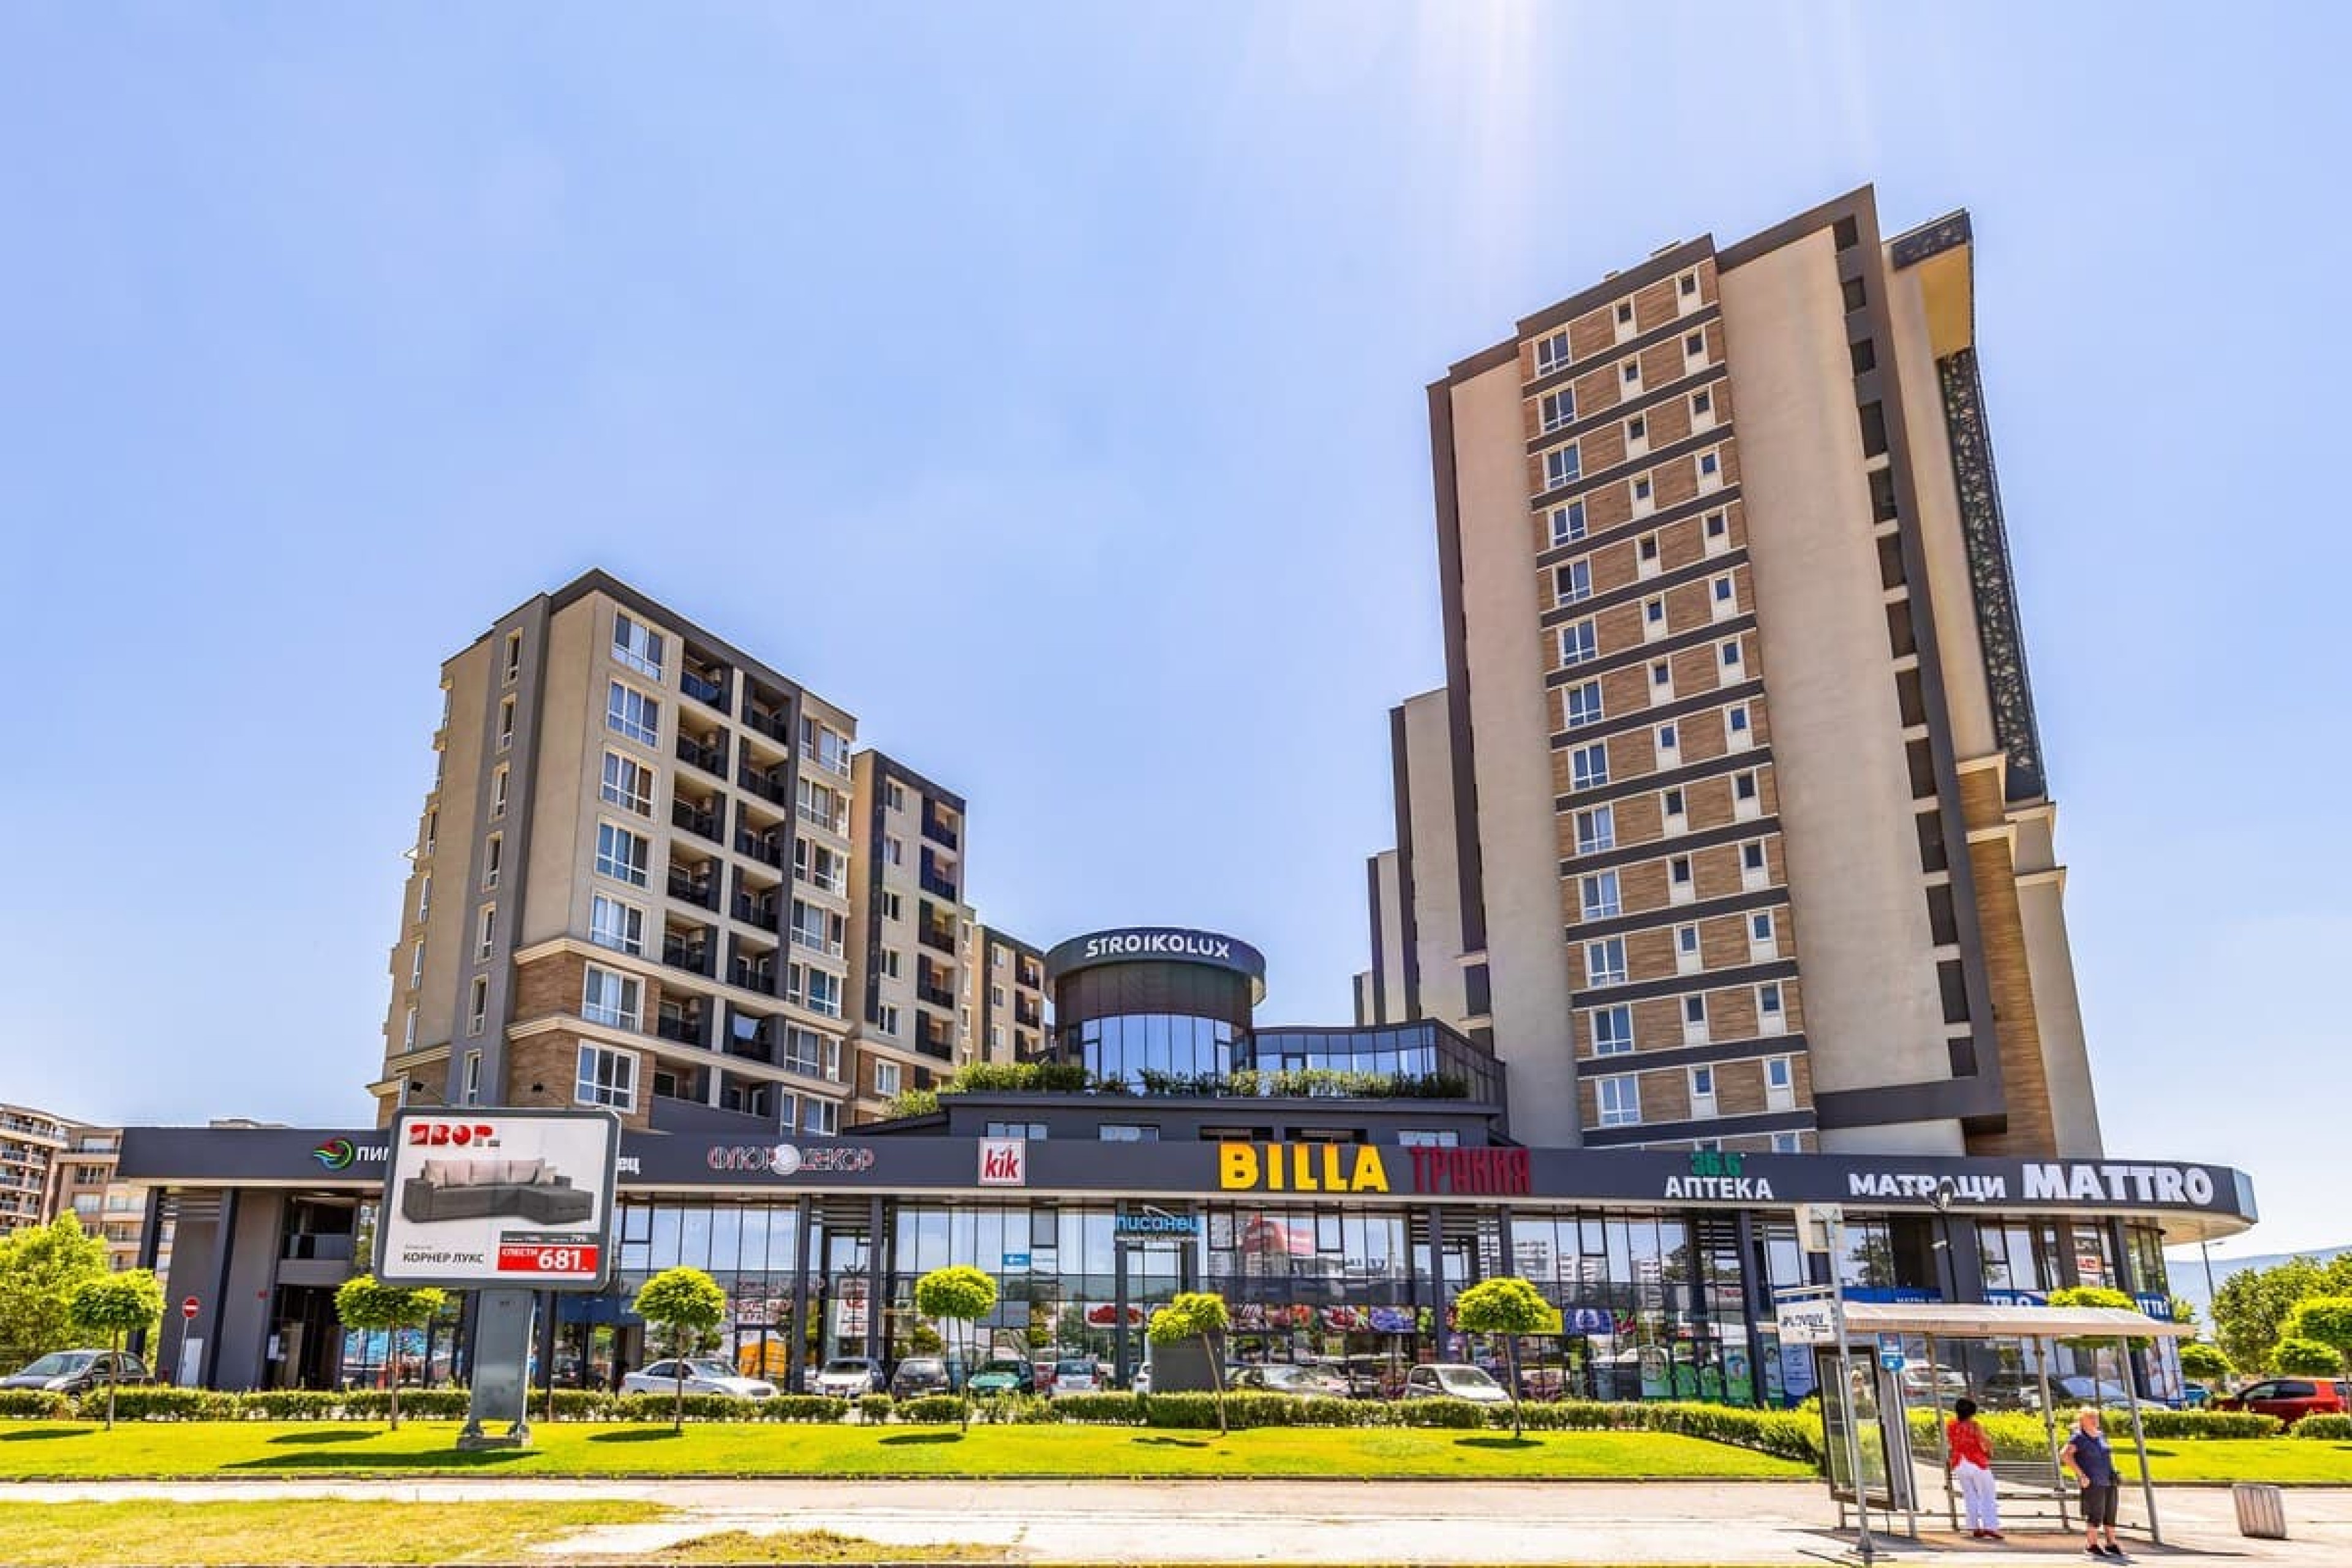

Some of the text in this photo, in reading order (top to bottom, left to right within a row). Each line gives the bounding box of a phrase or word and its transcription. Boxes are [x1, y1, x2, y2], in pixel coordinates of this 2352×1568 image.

[1085, 934, 1230, 958] STROIKOLUX
[986, 1145, 1019, 1178] kik
[1221, 1144, 1389, 1192] BILLA
[1410, 1146, 1530, 1194] ТРАКИЯ
[1664, 1176, 1774, 1200] АПТЕКА
[2022, 1163, 2214, 1205] MATTRO
